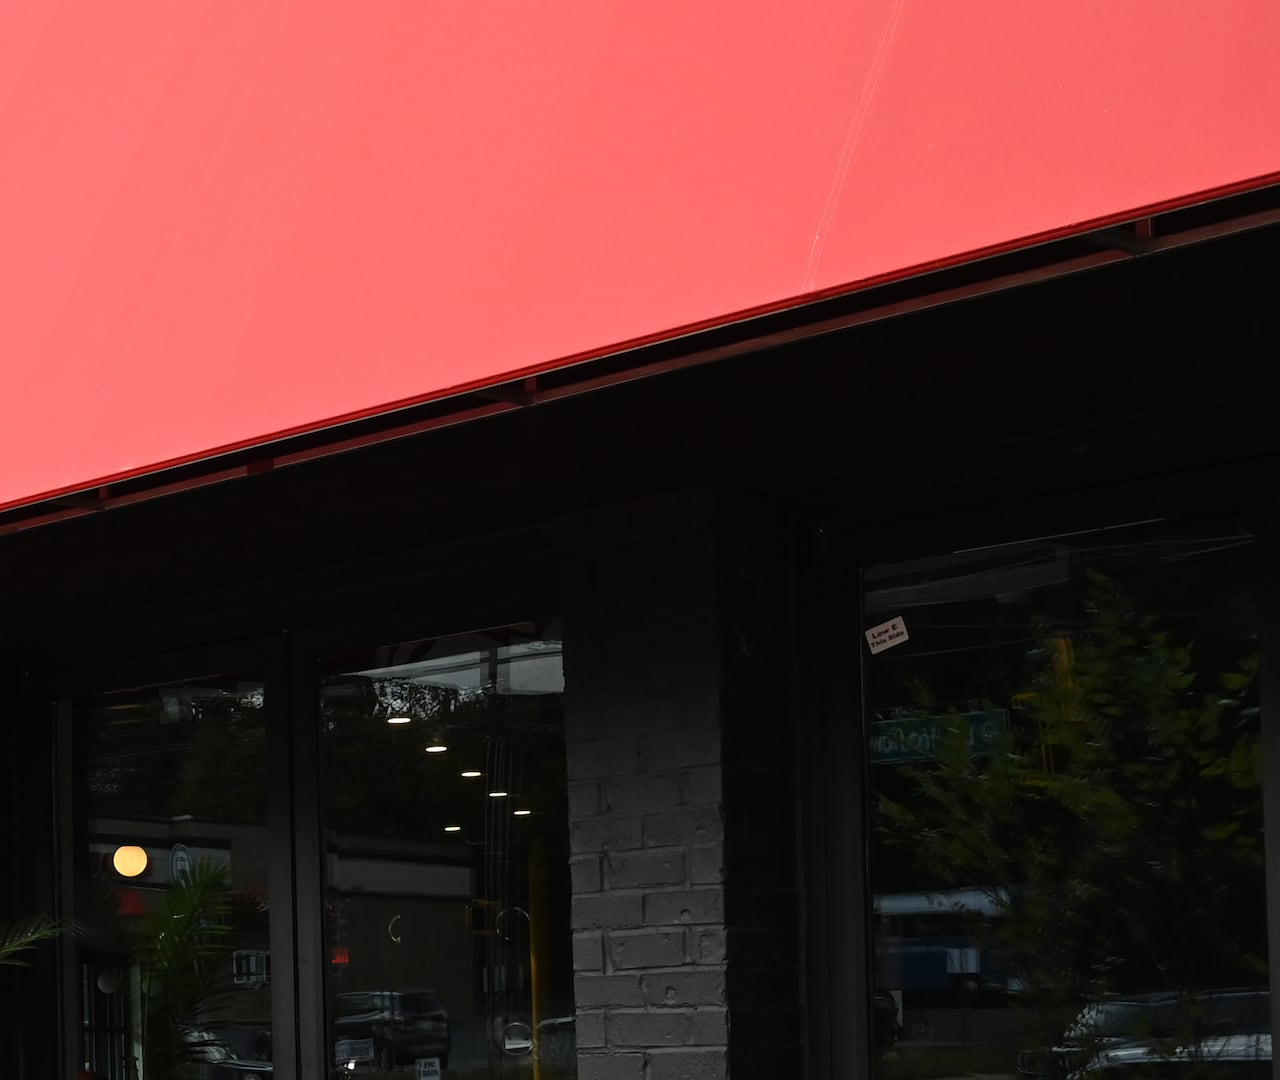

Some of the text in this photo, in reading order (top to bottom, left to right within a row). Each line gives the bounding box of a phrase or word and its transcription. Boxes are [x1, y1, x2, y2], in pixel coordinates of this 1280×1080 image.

[870, 631, 904, 648] This Side
[872, 628, 889, 639] Low
